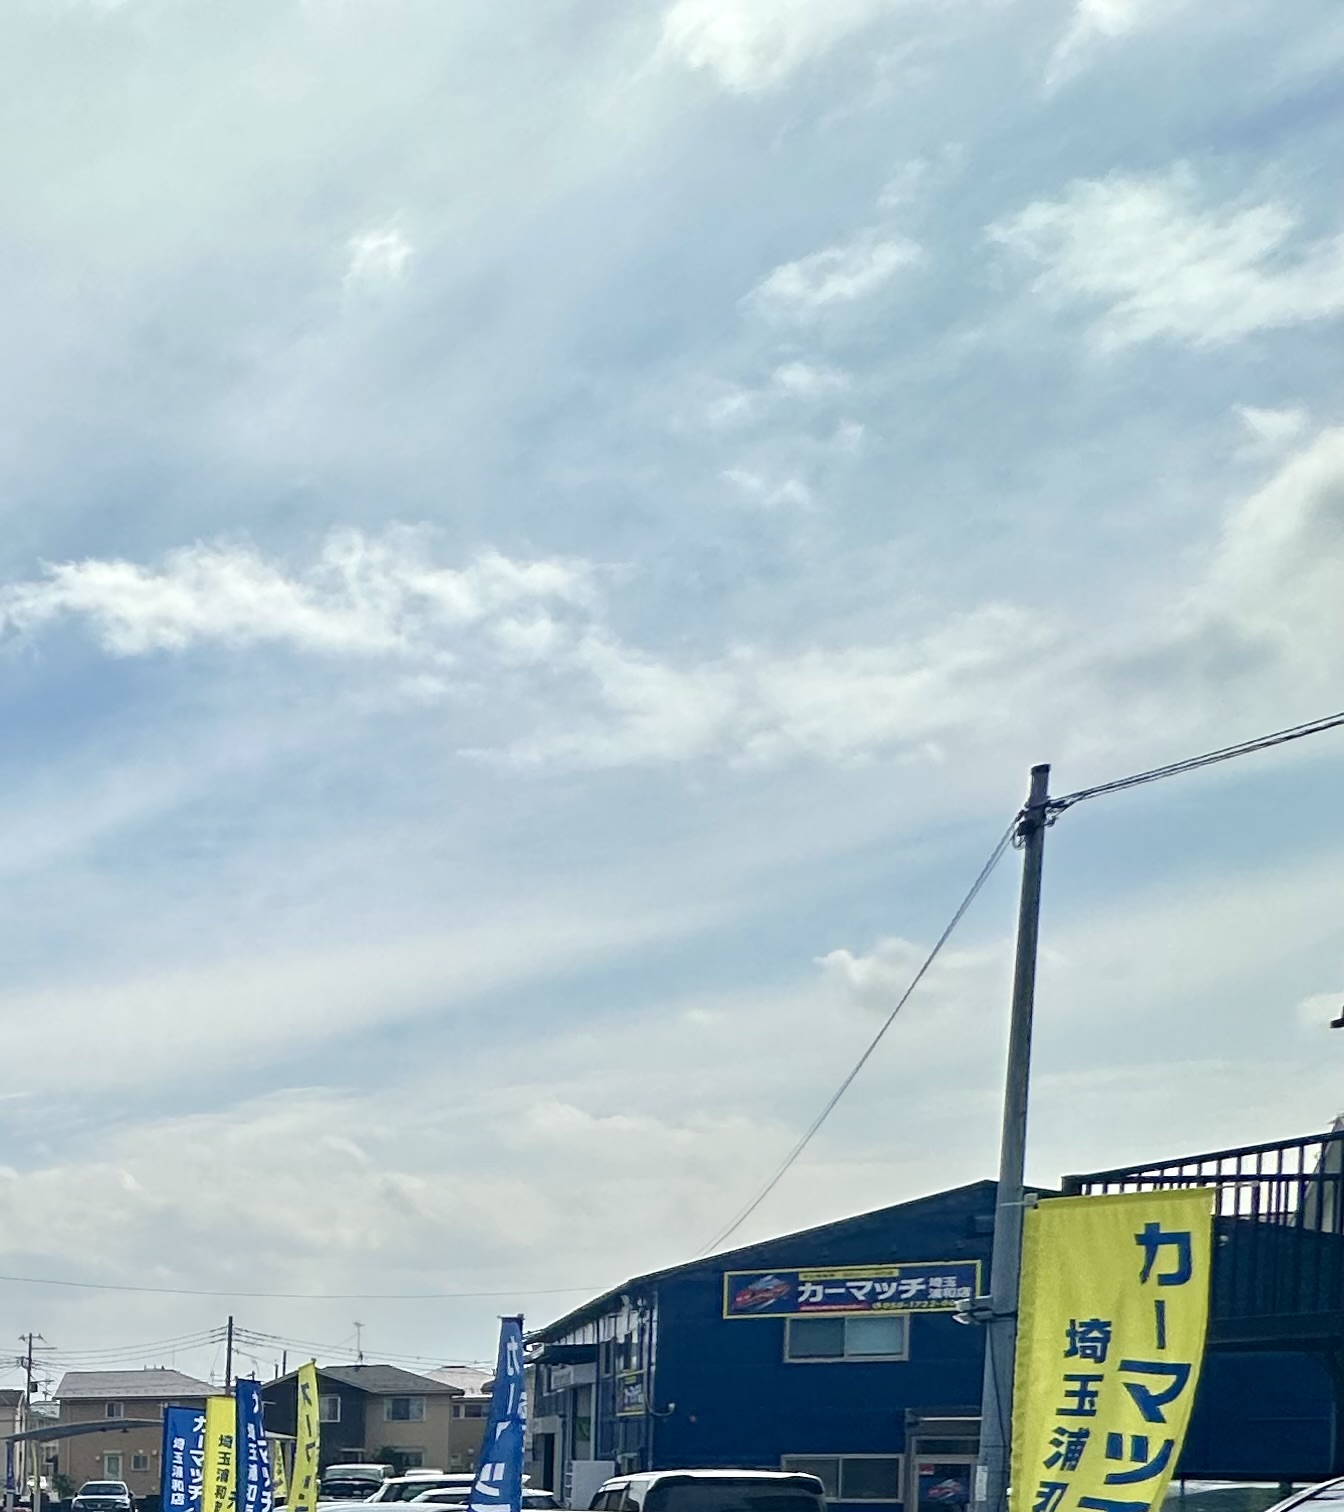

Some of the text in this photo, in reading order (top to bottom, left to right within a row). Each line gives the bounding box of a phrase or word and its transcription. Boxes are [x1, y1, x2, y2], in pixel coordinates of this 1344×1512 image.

[798, 1277, 927, 1303] カーマッチ
